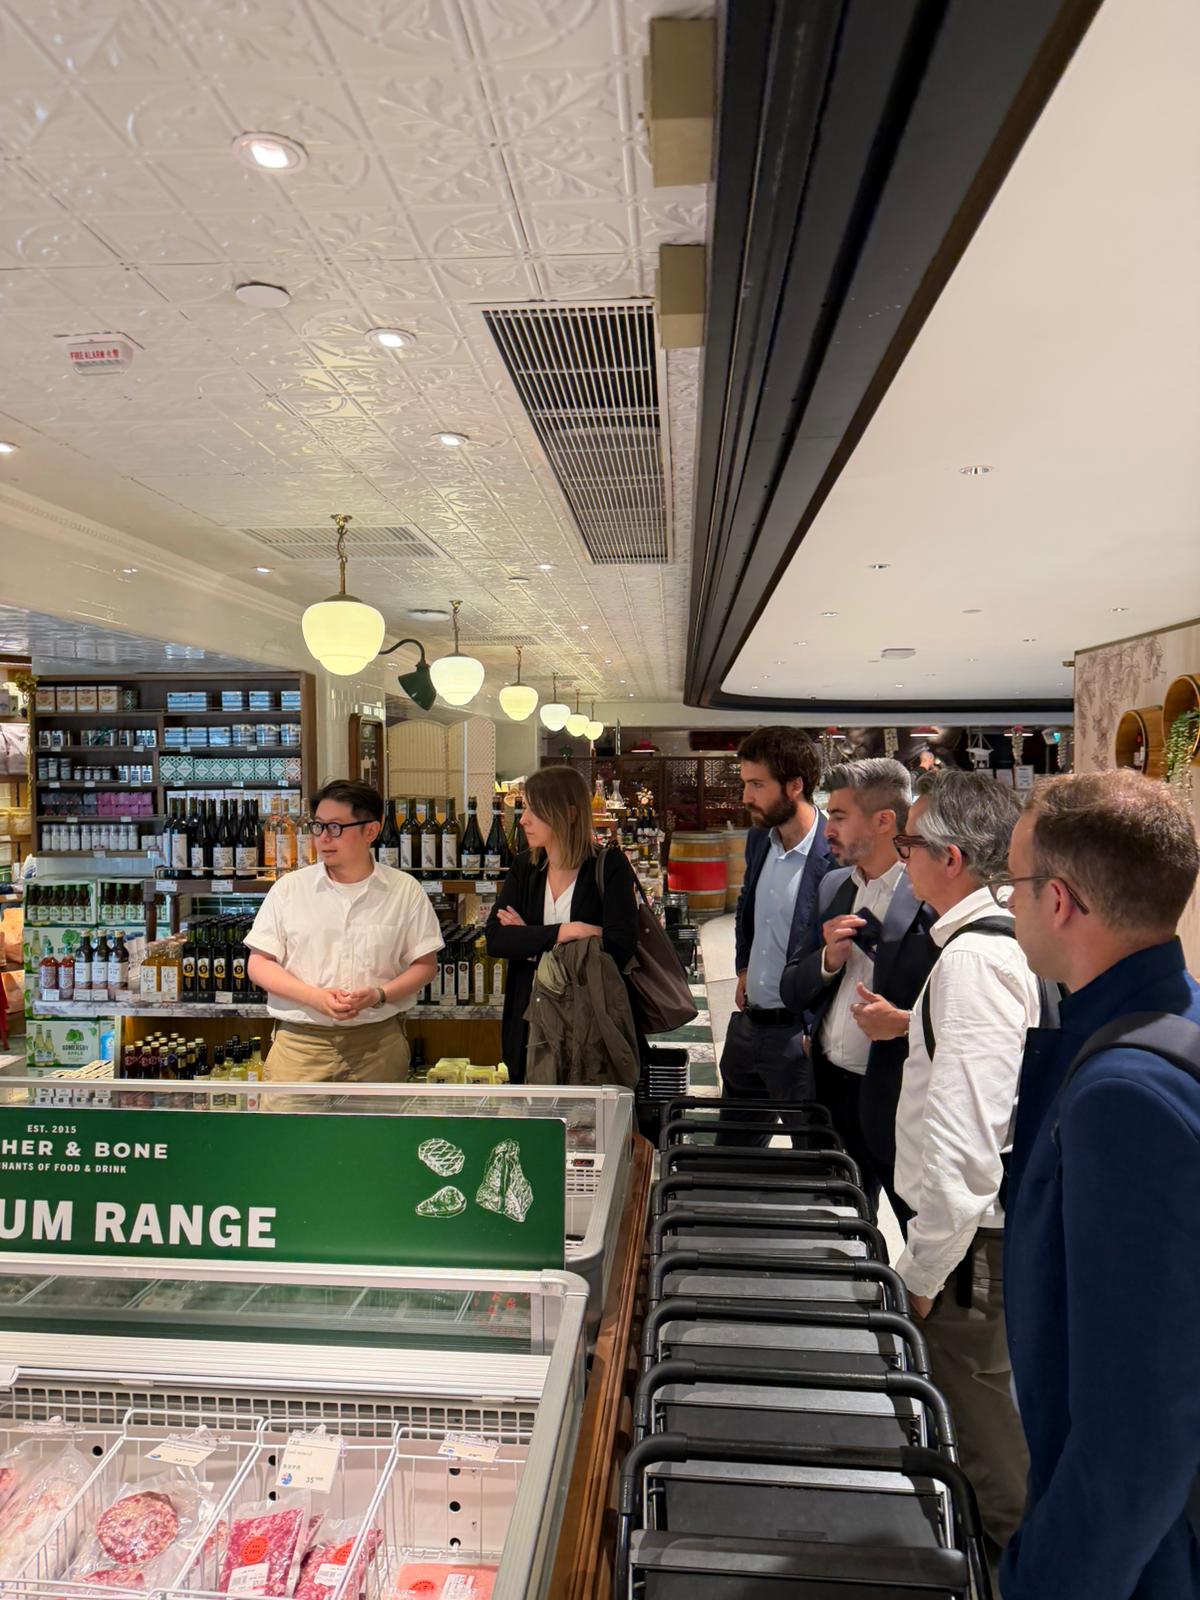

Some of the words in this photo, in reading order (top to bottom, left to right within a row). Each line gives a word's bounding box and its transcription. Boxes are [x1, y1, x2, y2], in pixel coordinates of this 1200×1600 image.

[27, 1124, 48, 1133] EST.
[52, 1125, 77, 1134] 2015
[65, 1141, 82, 1157] &
[94, 1142, 168, 1159] BONE
[38, 1163, 50, 1171] OF
[54, 1163, 80, 1172] FOOD
[84, 1164, 91, 1172] &
[95, 1165, 127, 1174] DRINK
[94, 1202, 277, 1249] RANGE
